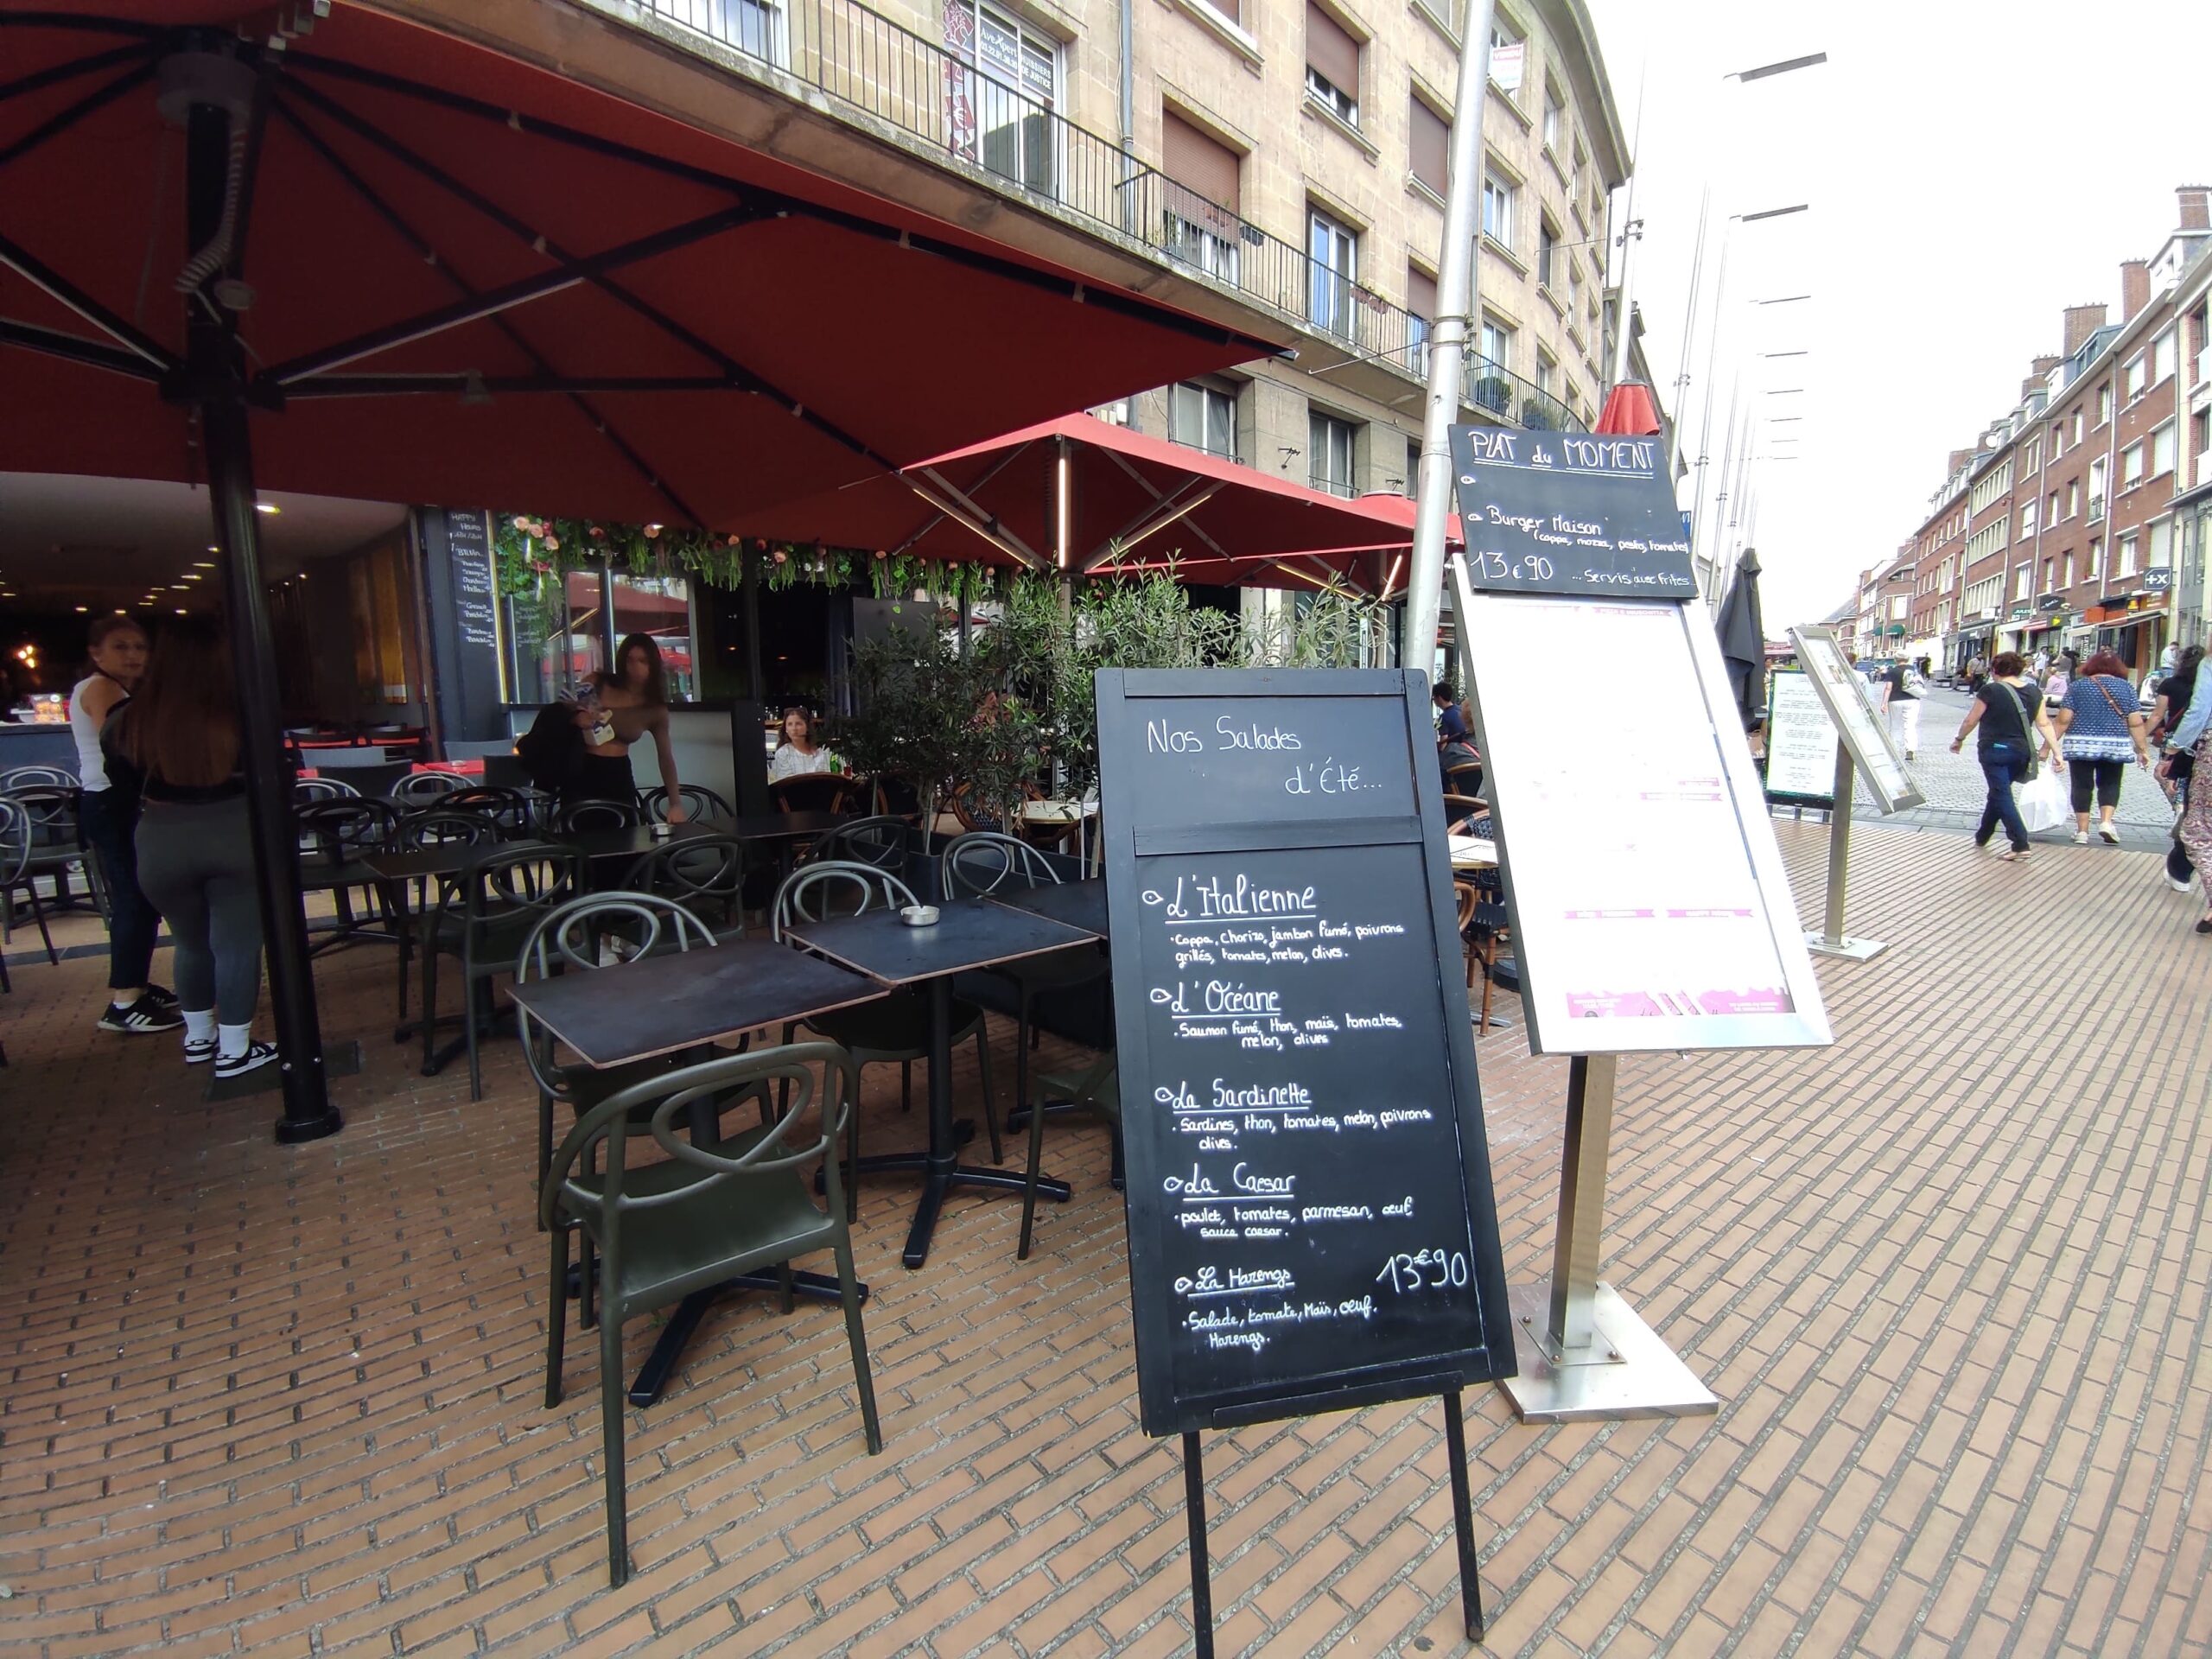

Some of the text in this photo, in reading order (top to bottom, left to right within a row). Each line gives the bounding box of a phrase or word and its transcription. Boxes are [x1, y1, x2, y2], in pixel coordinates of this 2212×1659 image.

[1021, 55, 1052, 79] HUISSIERS
[1030, 70, 1052, 90] JUSTICE
[1468, 431, 1655, 469] PLAT du MOMENT
[1486, 505, 1602, 536] Burger Maison
[1147, 716, 1301, 753] Nos Salades
[1167, 874, 1316, 917] L'Italienne
[1268, 925, 1313, 949] jambon
[1355, 924, 1404, 940] poivrons
[1172, 979, 1281, 1014] L'Océane
[1179, 1022, 1227, 1038] Saumon
[1294, 1033, 1329, 1046] olives
[1173, 1077, 1312, 1109] La Sardinette
[1380, 1108, 1432, 1129] poivrons
[1185, 1161, 1296, 1193] La Caesar
[1195, 1266, 1224, 1290] La
[1230, 1267, 1292, 1289] Harengs
